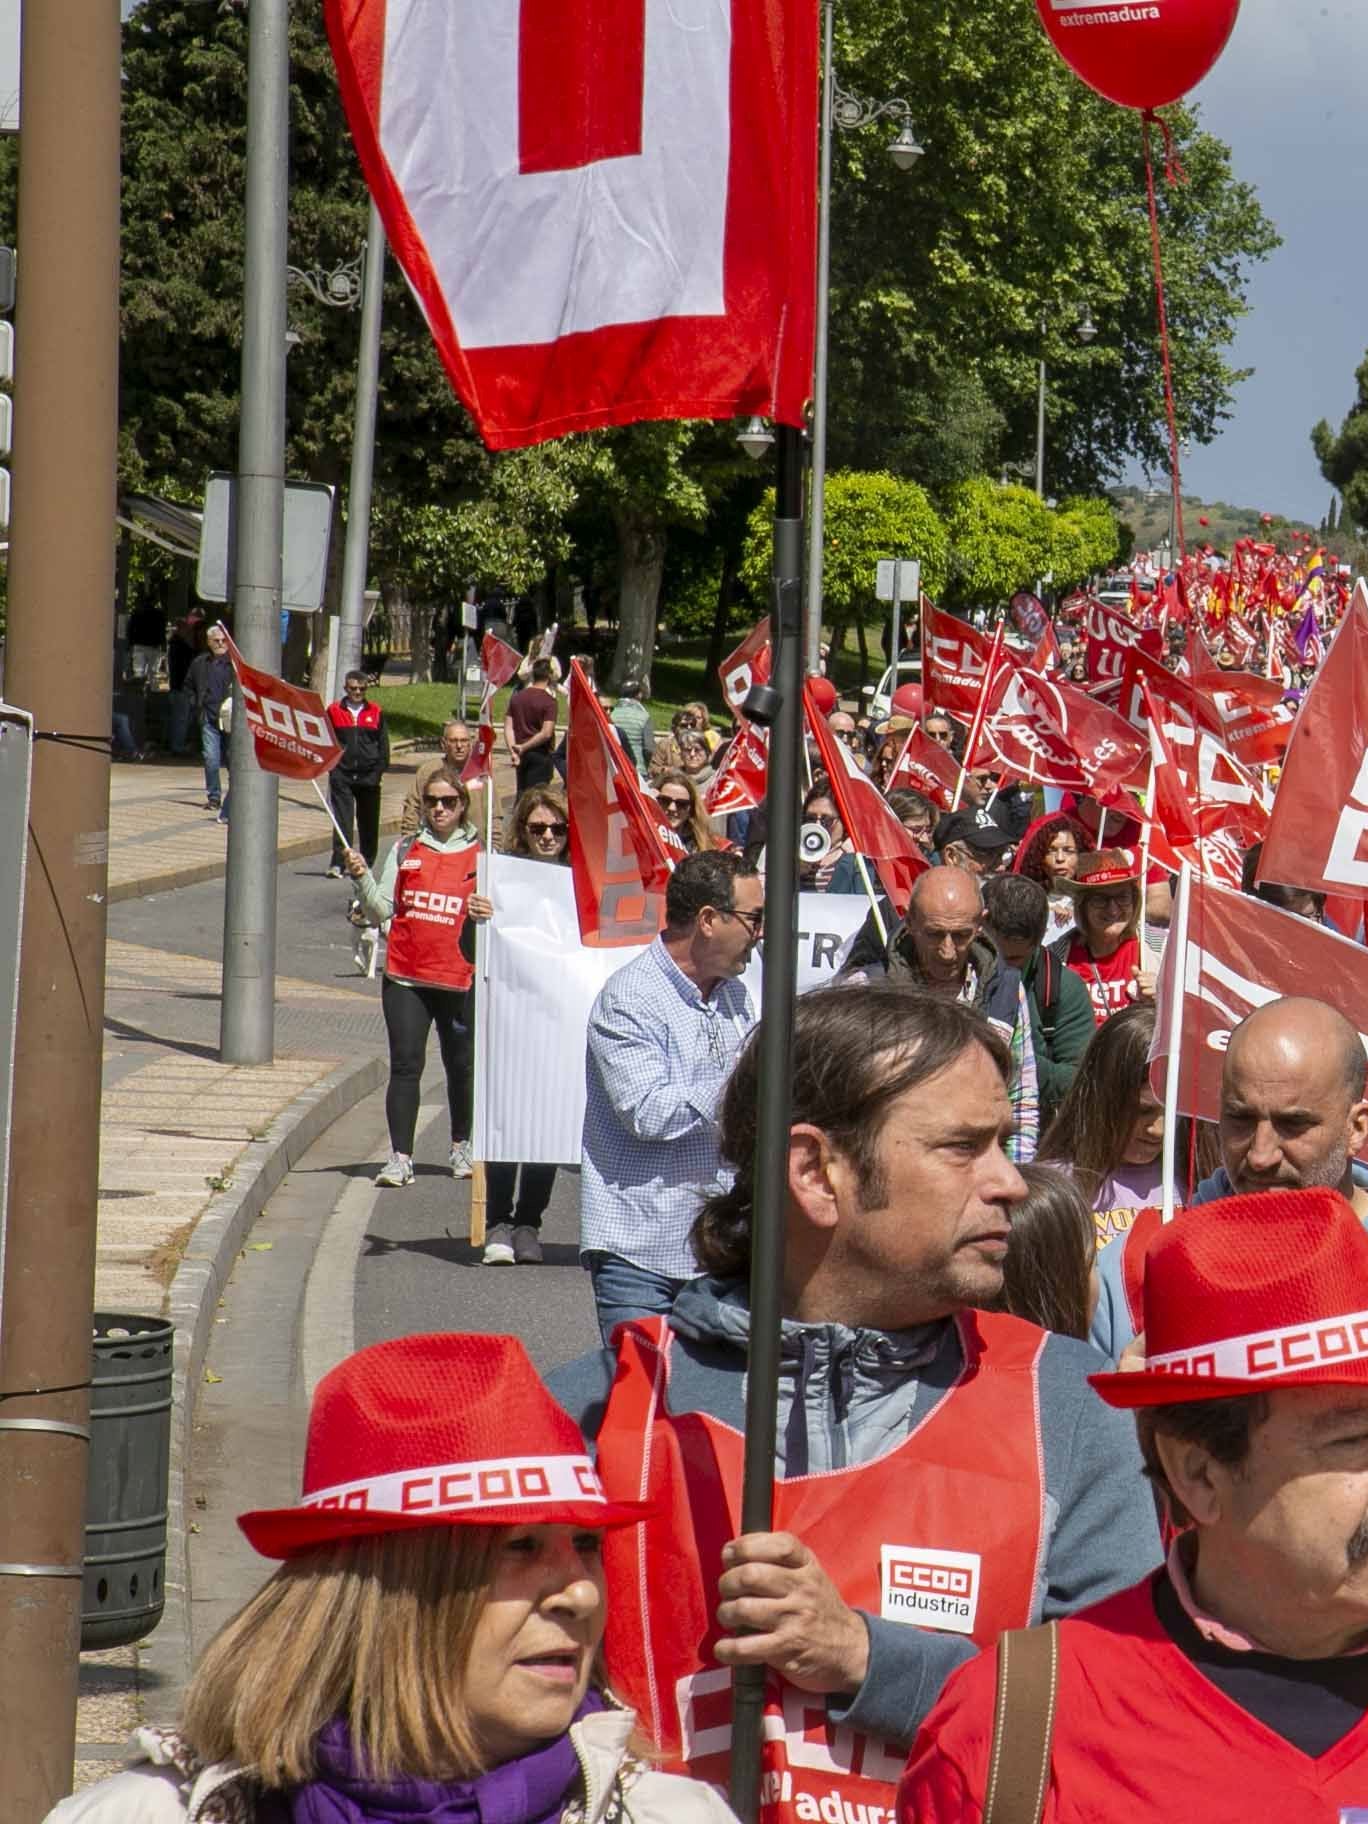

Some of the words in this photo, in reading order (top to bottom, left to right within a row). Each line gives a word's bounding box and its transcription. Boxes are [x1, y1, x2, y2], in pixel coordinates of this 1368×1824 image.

[1060, 6, 1160, 26] extremadura
[401, 1466, 551, 1512] CCOO
[893, 1564, 969, 1593] CCOO
[888, 1588, 971, 1617] industria
